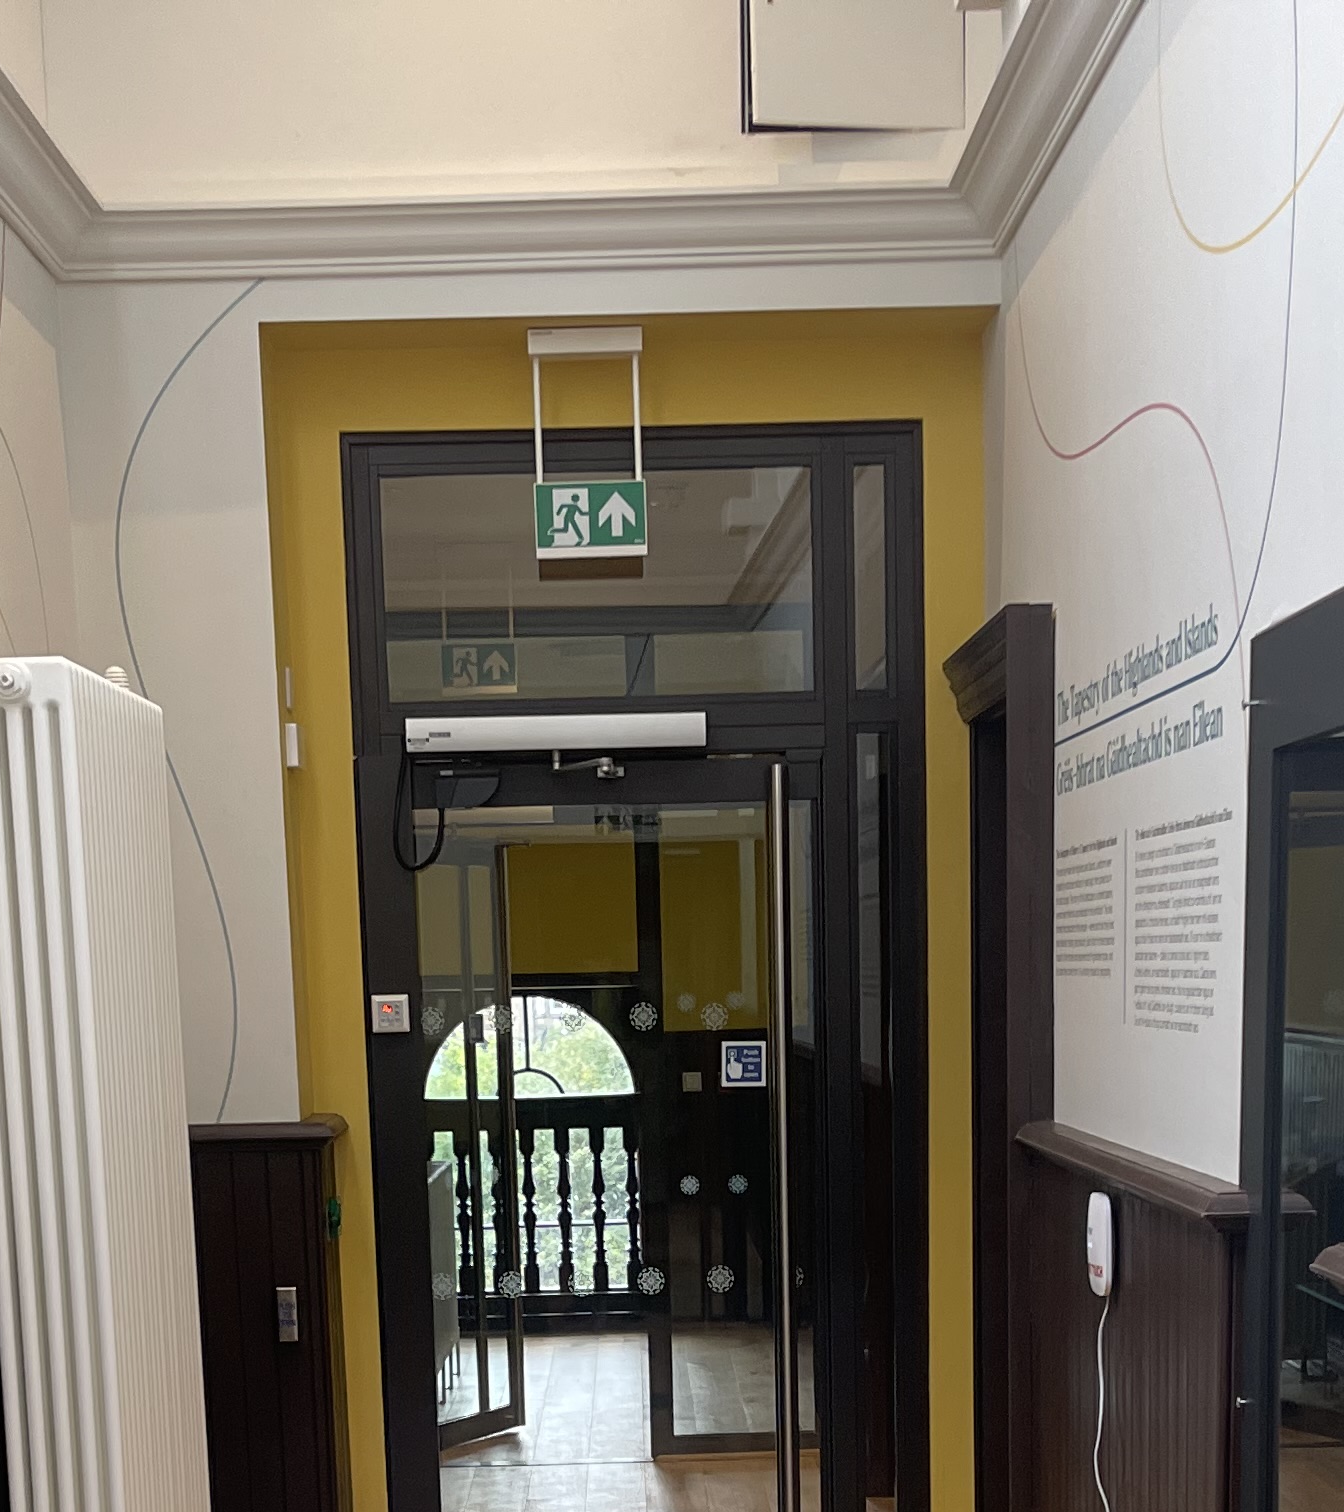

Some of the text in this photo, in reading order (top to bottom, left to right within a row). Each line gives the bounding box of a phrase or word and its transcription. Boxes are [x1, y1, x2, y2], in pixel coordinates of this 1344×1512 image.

[1057, 603, 1218, 725] The Tapestry of the Highlands and Islands
[1096, 753, 1105, 781] na
[1164, 715, 1172, 757] is
[1173, 719, 1191, 753] nan
[1193, 700, 1223, 746] Eilean
